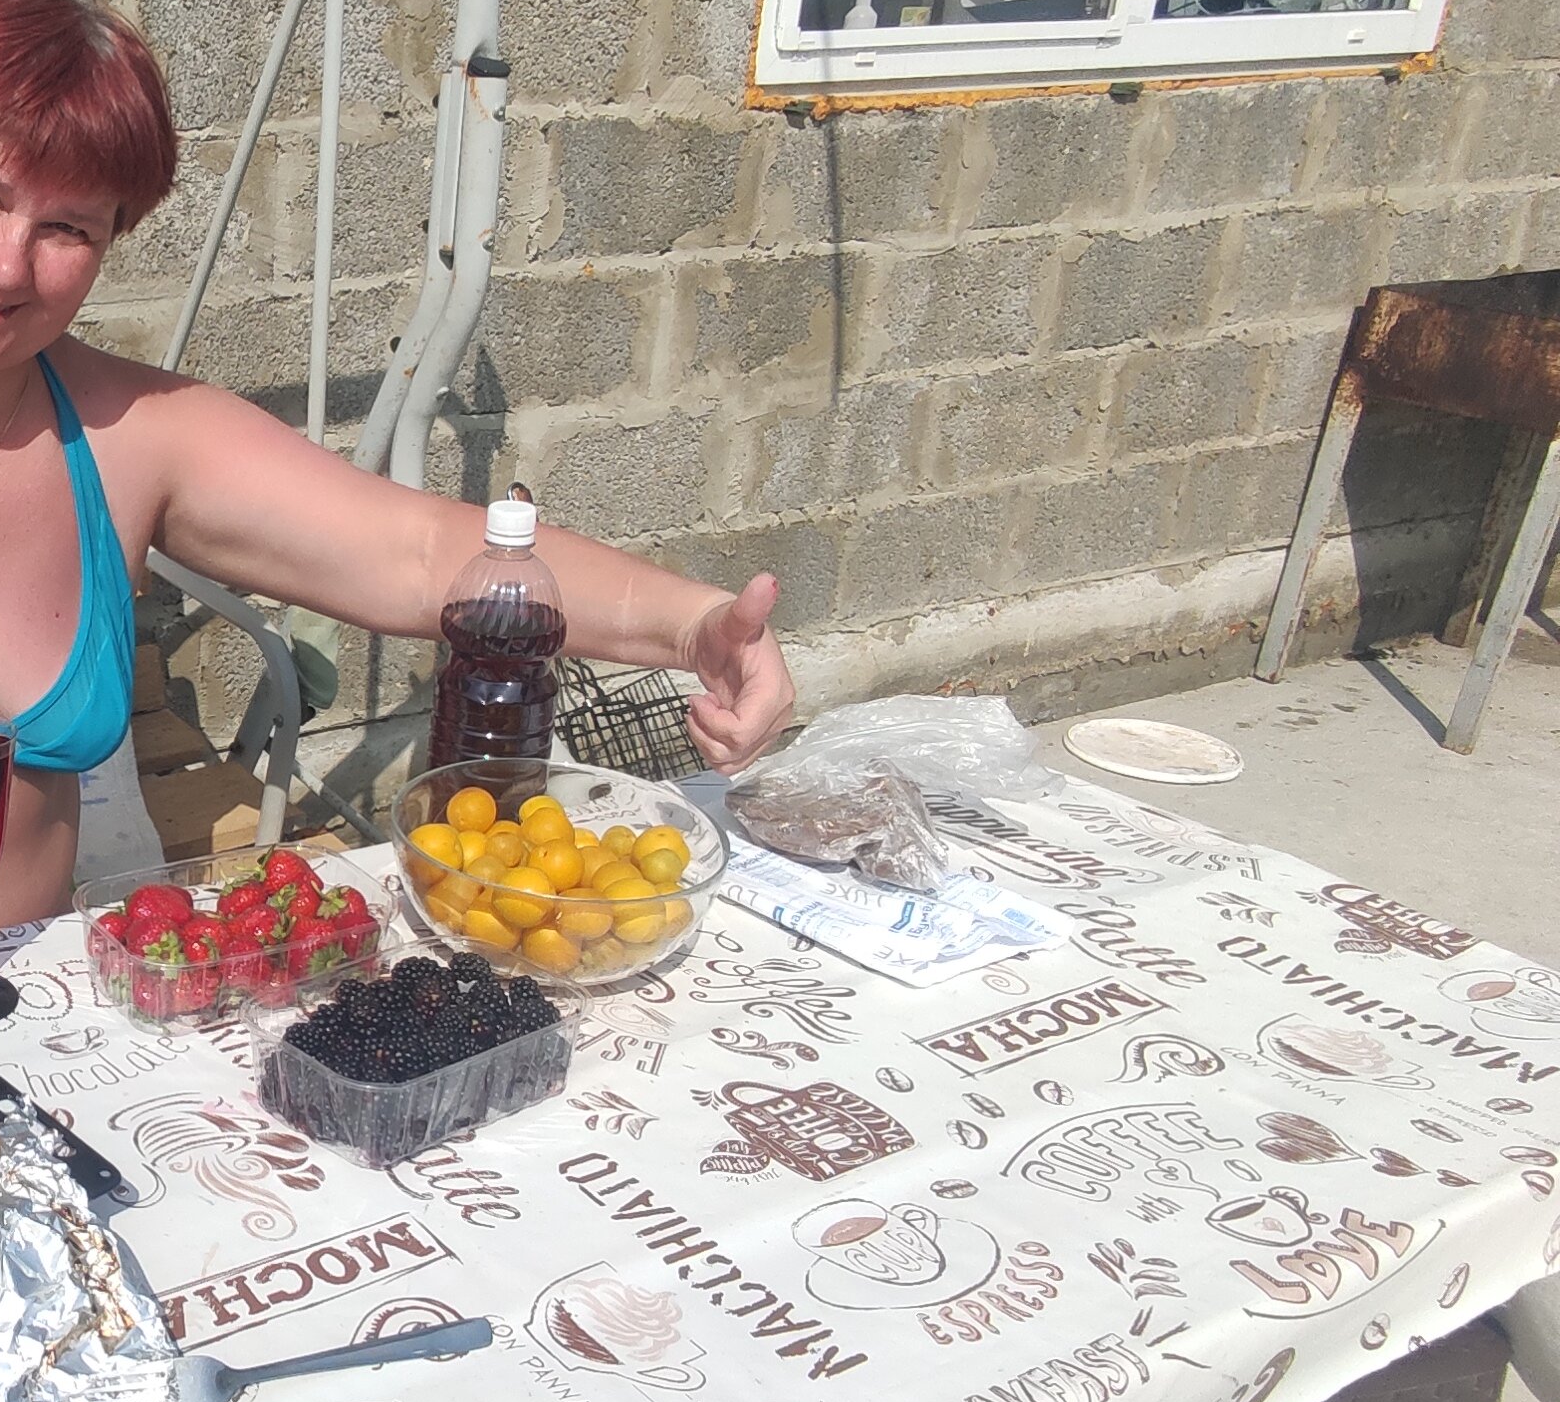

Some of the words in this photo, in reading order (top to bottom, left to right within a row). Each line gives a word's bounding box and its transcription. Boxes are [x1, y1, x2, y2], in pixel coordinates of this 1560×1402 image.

[929, 982, 1153, 1062] MOCHA
[764, 1097, 875, 1166] COFFEE
[1021, 1110, 1244, 1203] COFFEE
[1126, 1192, 1184, 1225] with
[558, 1152, 868, 1380] MACCHIATO
[845, 1227, 941, 1282] CUP
[916, 1241, 1064, 1346] ESPRESSO
[1229, 1207, 1415, 1304] LOVE
